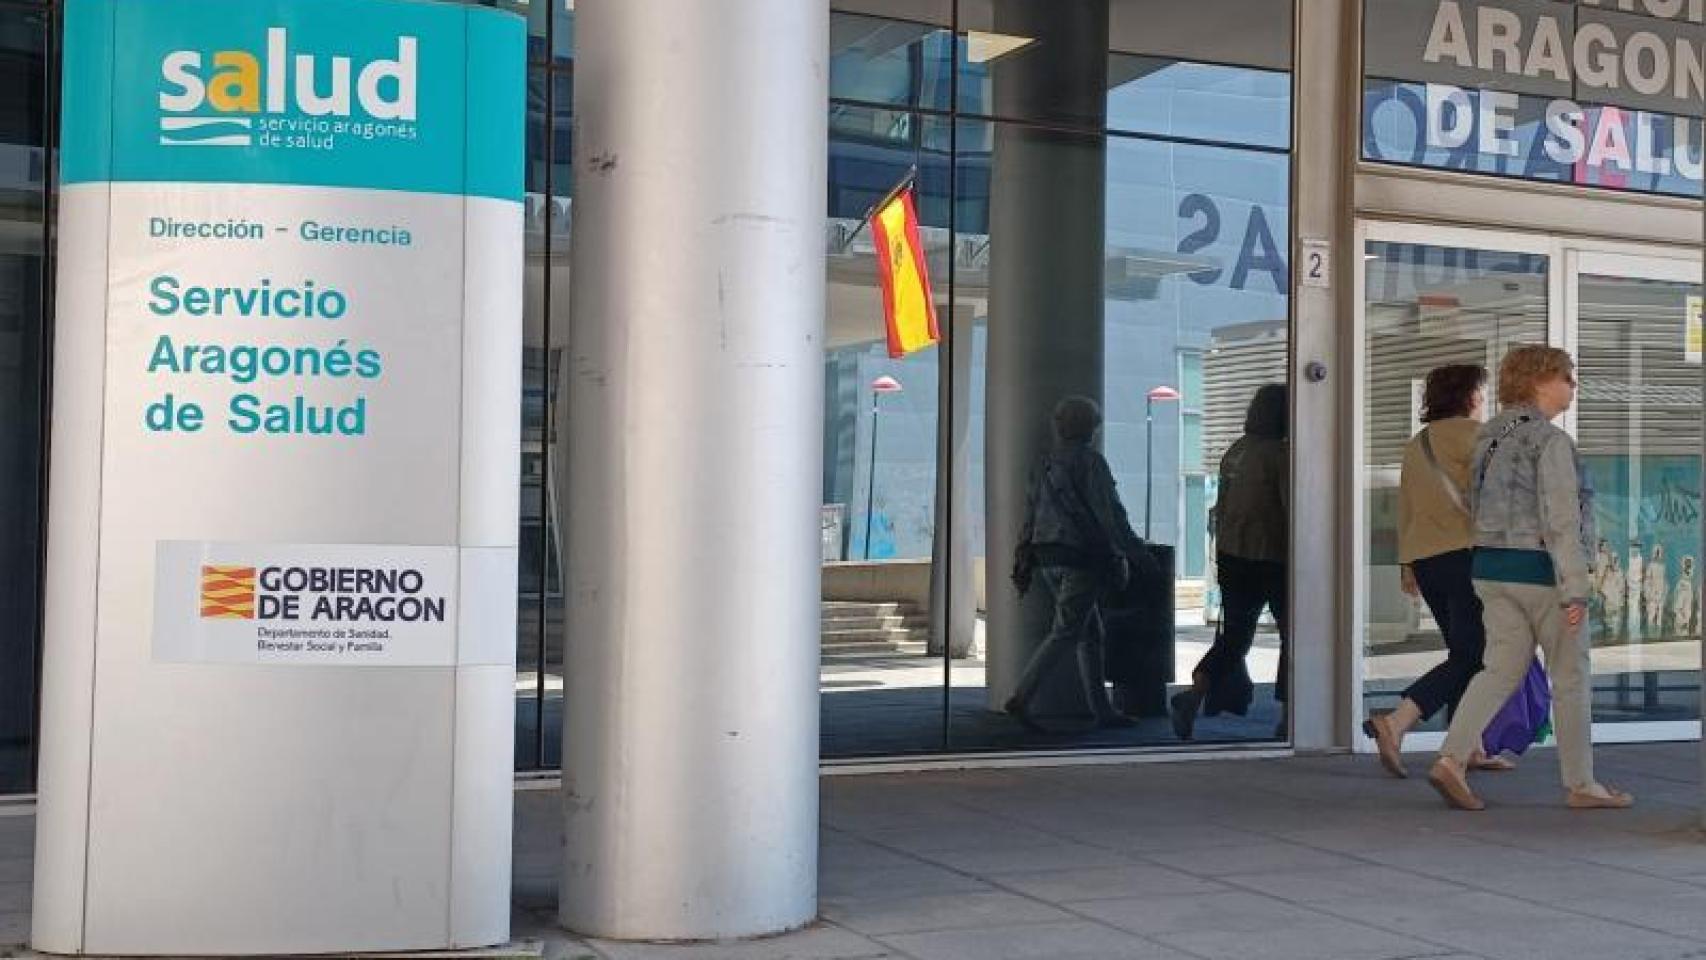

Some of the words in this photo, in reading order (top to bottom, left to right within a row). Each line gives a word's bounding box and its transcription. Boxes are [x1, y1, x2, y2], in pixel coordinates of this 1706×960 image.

[159, 27, 417, 120] salud
[259, 117, 329, 132] servicio
[1426, 83, 1519, 156] DE
[259, 131, 281, 147] de
[287, 133, 334, 149] salud
[149, 217, 264, 239] Dirección
[300, 221, 411, 246] Gerencia
[1310, 252, 1321, 277] 2
[148, 275, 347, 319] Servicio
[146, 334, 381, 383] Aragonés
[145, 394, 204, 431] de
[228, 394, 366, 436] Salud
[259, 567, 423, 594] GOBIERNO
[257, 595, 299, 620] DE
[311, 596, 444, 622] ARAGON
[257, 627, 330, 639] Departamento
[332, 628, 346, 639] de
[307, 640, 336, 651] Social
